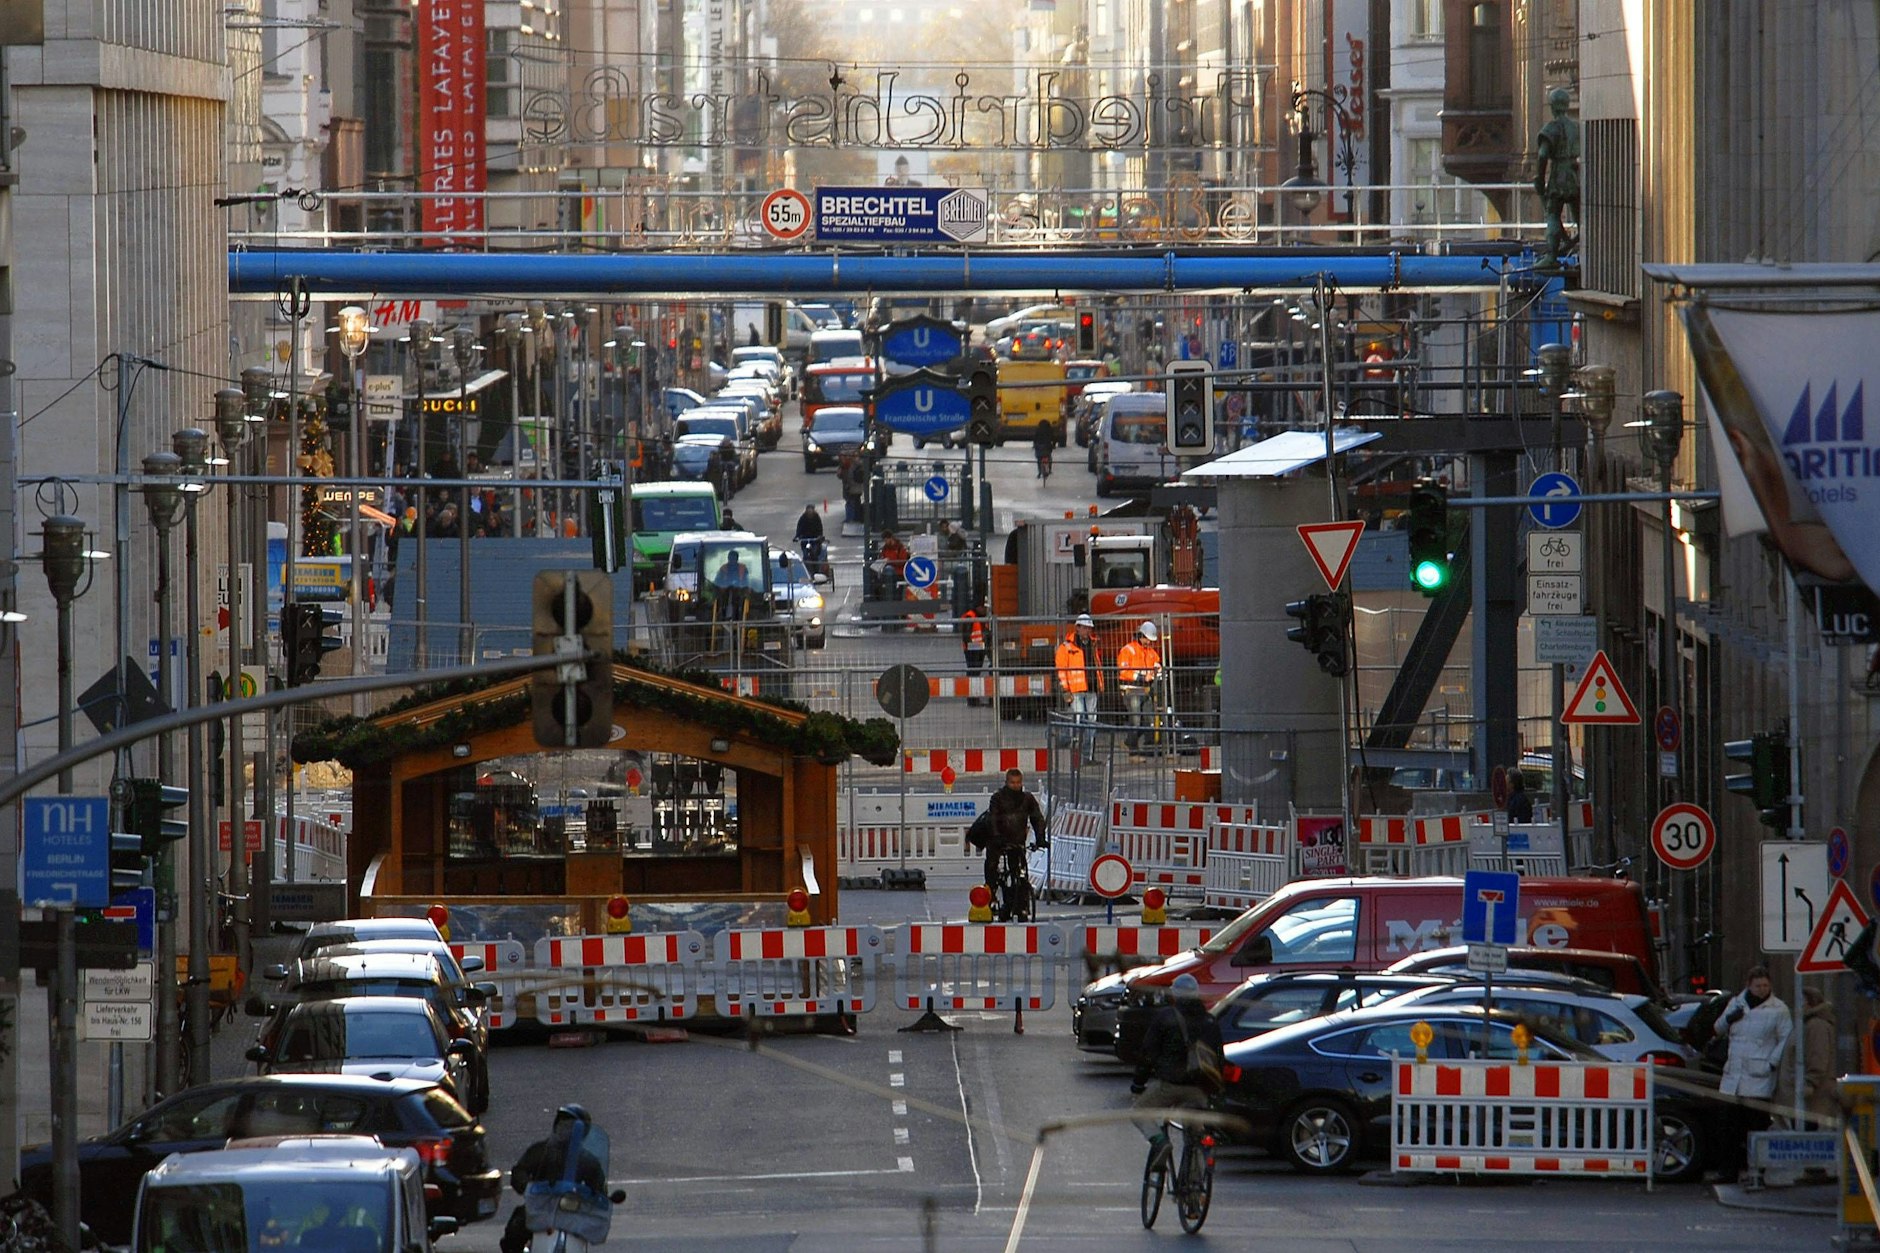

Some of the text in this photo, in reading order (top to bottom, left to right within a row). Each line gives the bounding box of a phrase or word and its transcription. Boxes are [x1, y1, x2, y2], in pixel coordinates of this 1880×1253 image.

[711, 28, 722, 68] WALL
[822, 197, 933, 215] BRECHTEL
[822, 216, 905, 227] SPEZIALTIEFBAU
[375, 300, 421, 326] H&M
[913, 328, 930, 348] U
[915, 390, 934, 412] U
[885, 413, 965, 422] Französische Straße
[1547, 559, 1564, 568] frei
[1536, 580, 1573, 589] Einsatz-
[1533, 591, 1577, 602] fahrzeuge
[1547, 602, 1563, 610] frei
[928, 802, 976, 810] NIEMEIER
[42, 835, 92, 845] HOTELES
[1666, 821, 1701, 851] 30
[1305, 846, 1337, 859] SINGLE
[47, 854, 85, 864] BERLIN
[1317, 855, 1345, 866] PARTY
[1533, 898, 1599, 908] www.miele.de
[104, 986, 130, 995] für LKW
[96, 1004, 137, 1013] Lieferverkehr
[110, 1028, 121, 1036] frei
[1769, 1139, 1835, 1152] NIEMEIER
